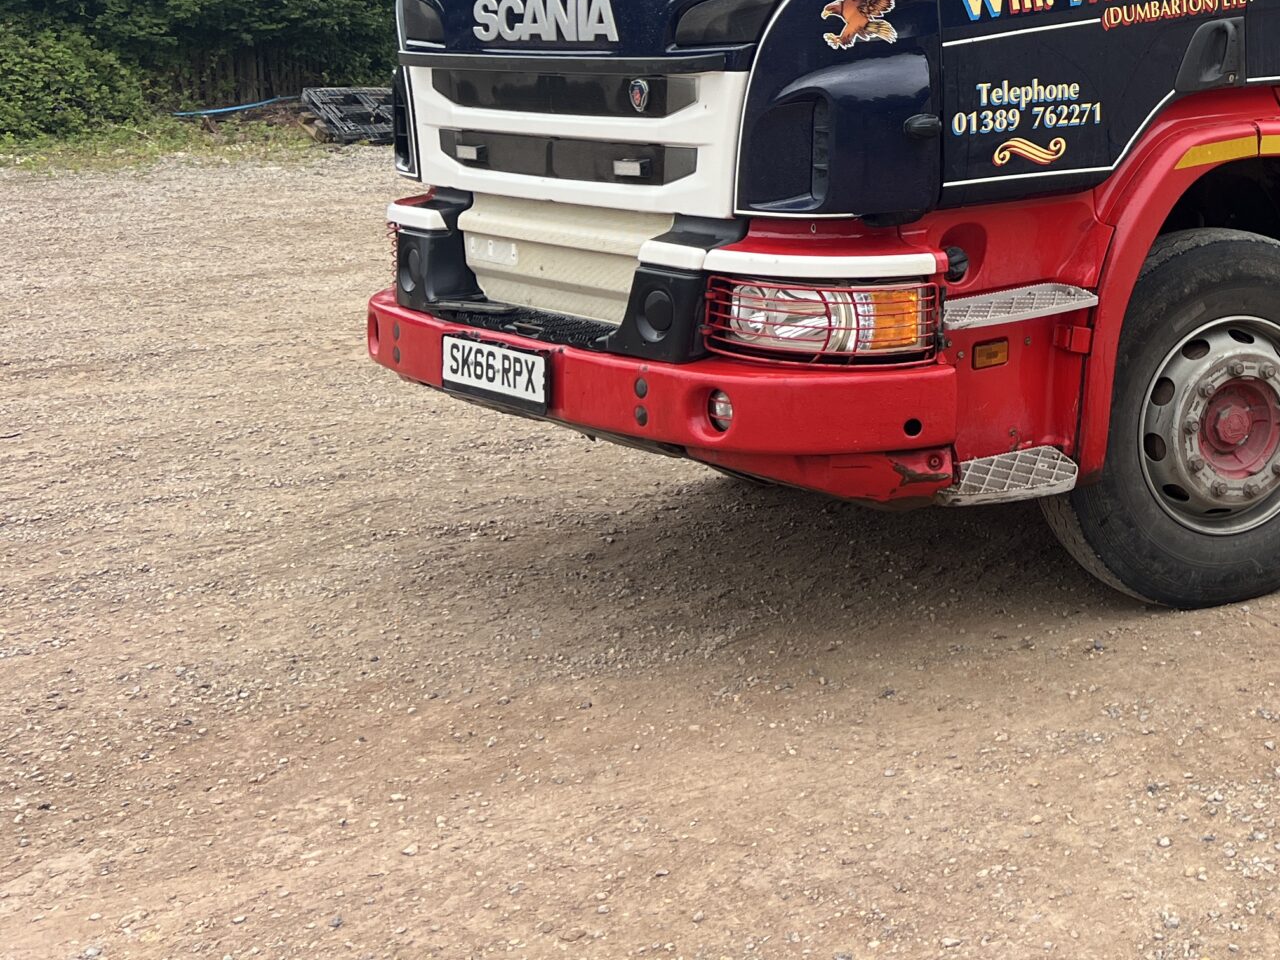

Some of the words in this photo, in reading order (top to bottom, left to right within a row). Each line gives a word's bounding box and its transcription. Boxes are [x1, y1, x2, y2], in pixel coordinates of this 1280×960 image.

[976, 79, 1080, 108] Telephone
[952, 108, 1021, 136] 01389
[1032, 102, 1102, 129] 762271
[450, 343, 497, 383] SK66
[501, 354, 536, 394] RPX
